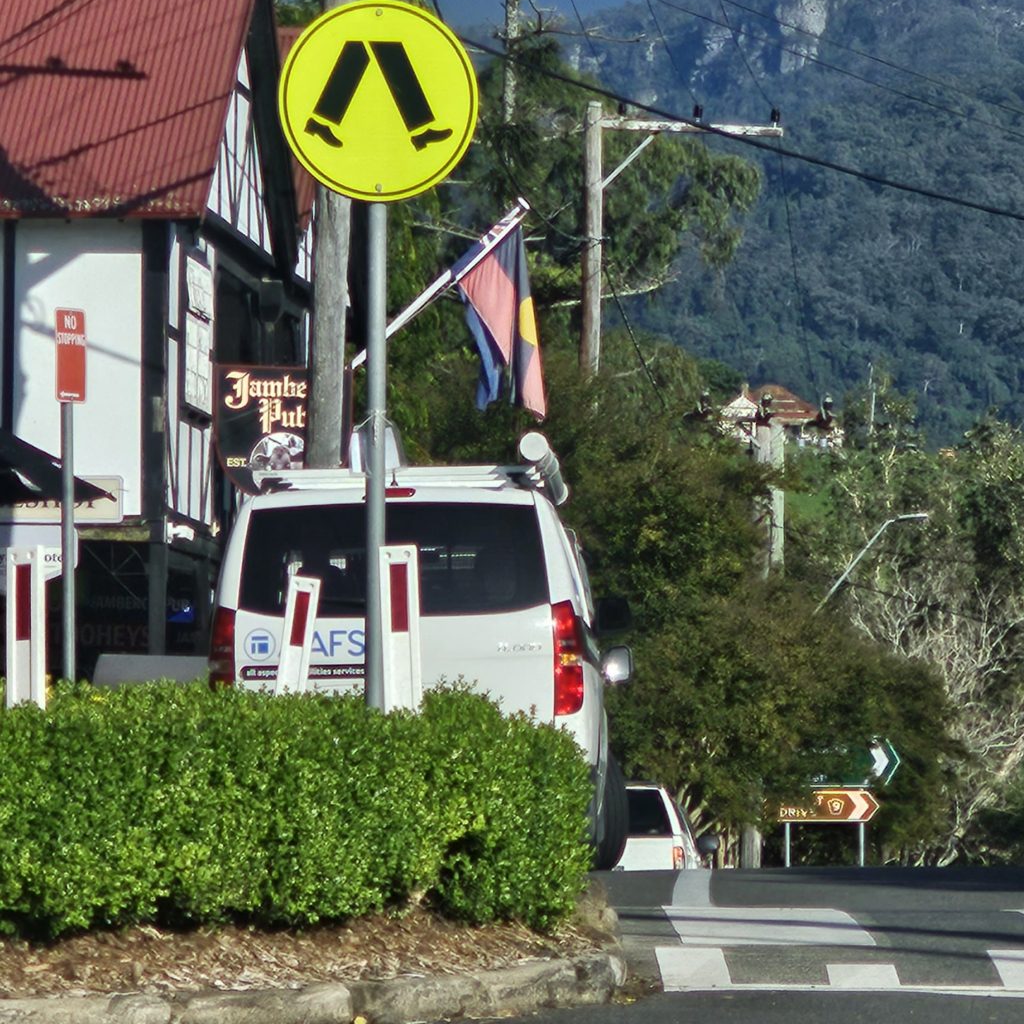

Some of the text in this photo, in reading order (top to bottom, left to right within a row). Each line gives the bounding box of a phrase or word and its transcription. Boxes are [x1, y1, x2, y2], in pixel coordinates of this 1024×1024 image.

[64, 315, 77, 330] NO
[57, 332, 86, 346] STOPPING
[831, 802, 841, 812] 9
